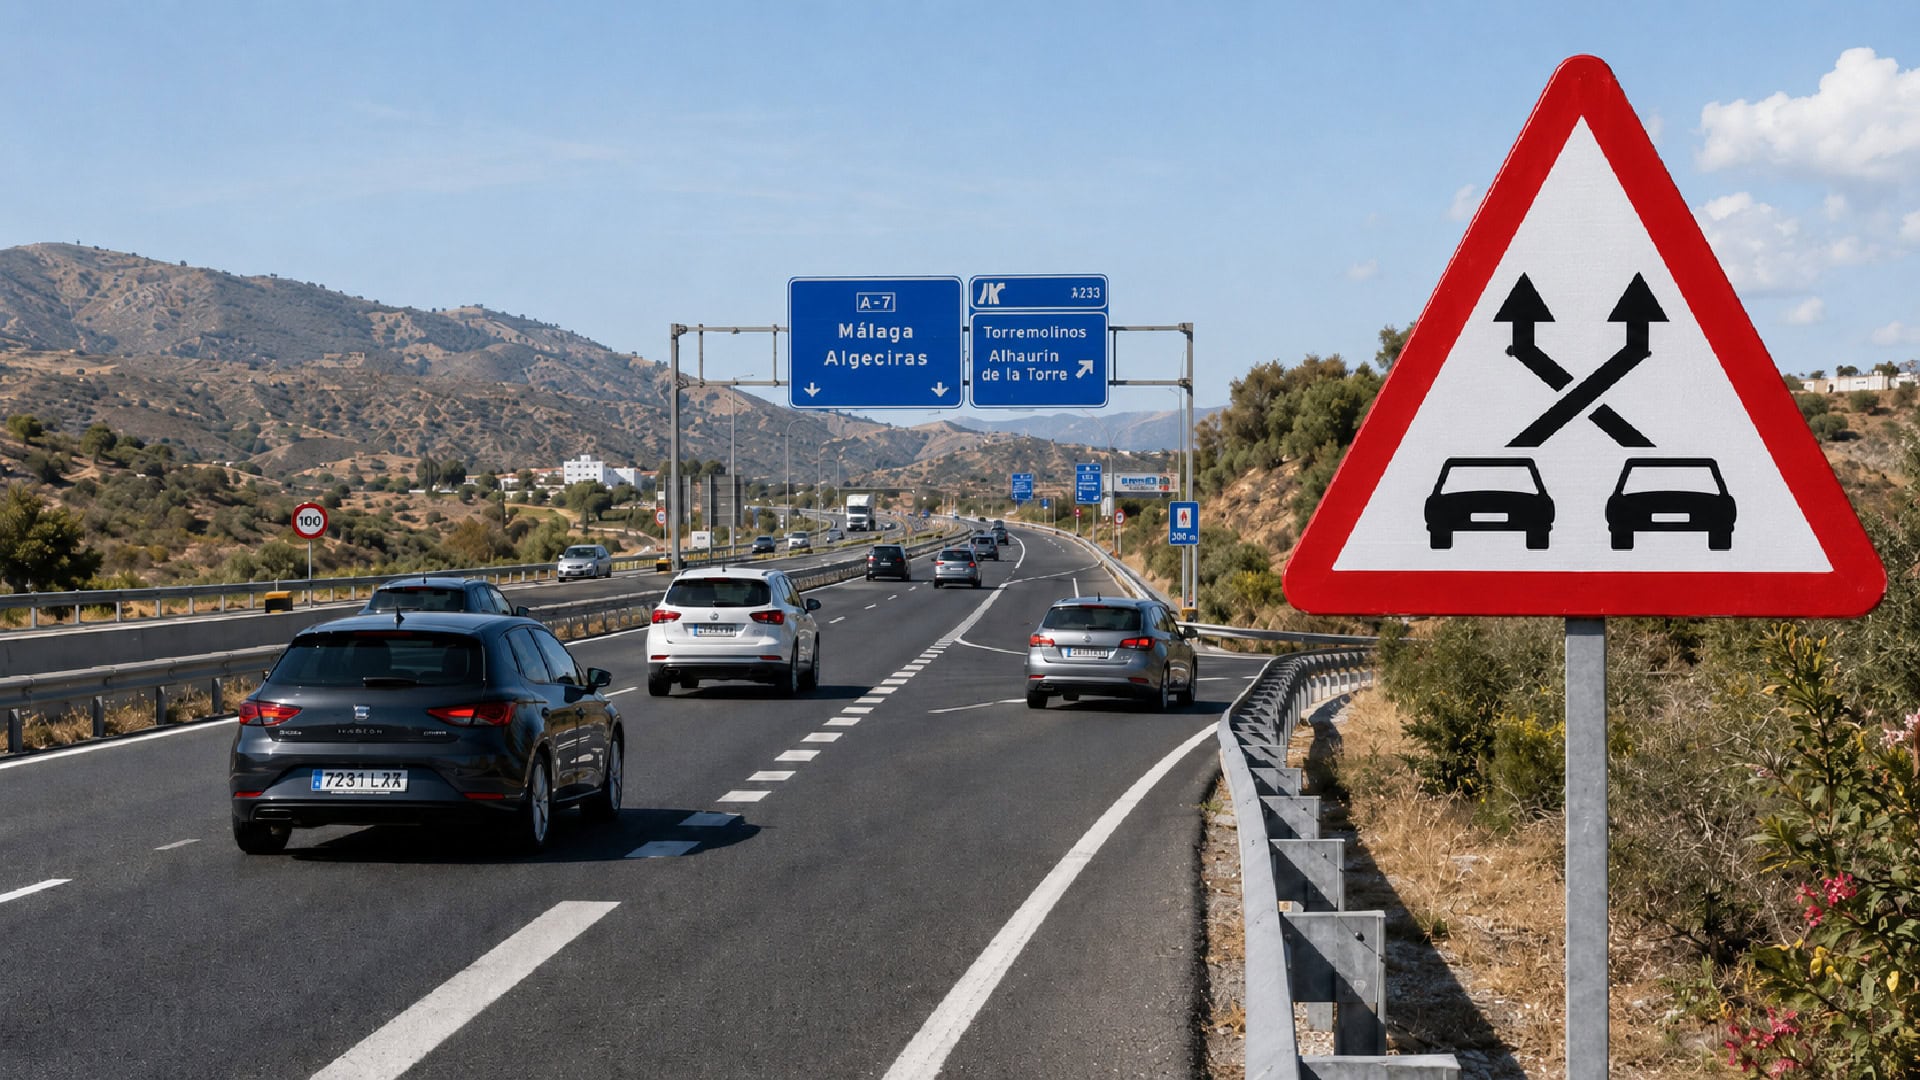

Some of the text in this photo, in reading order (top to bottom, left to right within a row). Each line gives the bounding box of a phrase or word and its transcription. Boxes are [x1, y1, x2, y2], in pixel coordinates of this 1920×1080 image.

[860, 295, 891, 309] A-7
[838, 322, 913, 343] Málaga
[983, 326, 1087, 339] Torremolinos
[823, 349, 928, 370] Algeciras
[982, 367, 1068, 381] de la Torre
[299, 515, 321, 527] 100
[325, 771, 365, 788] 7231
